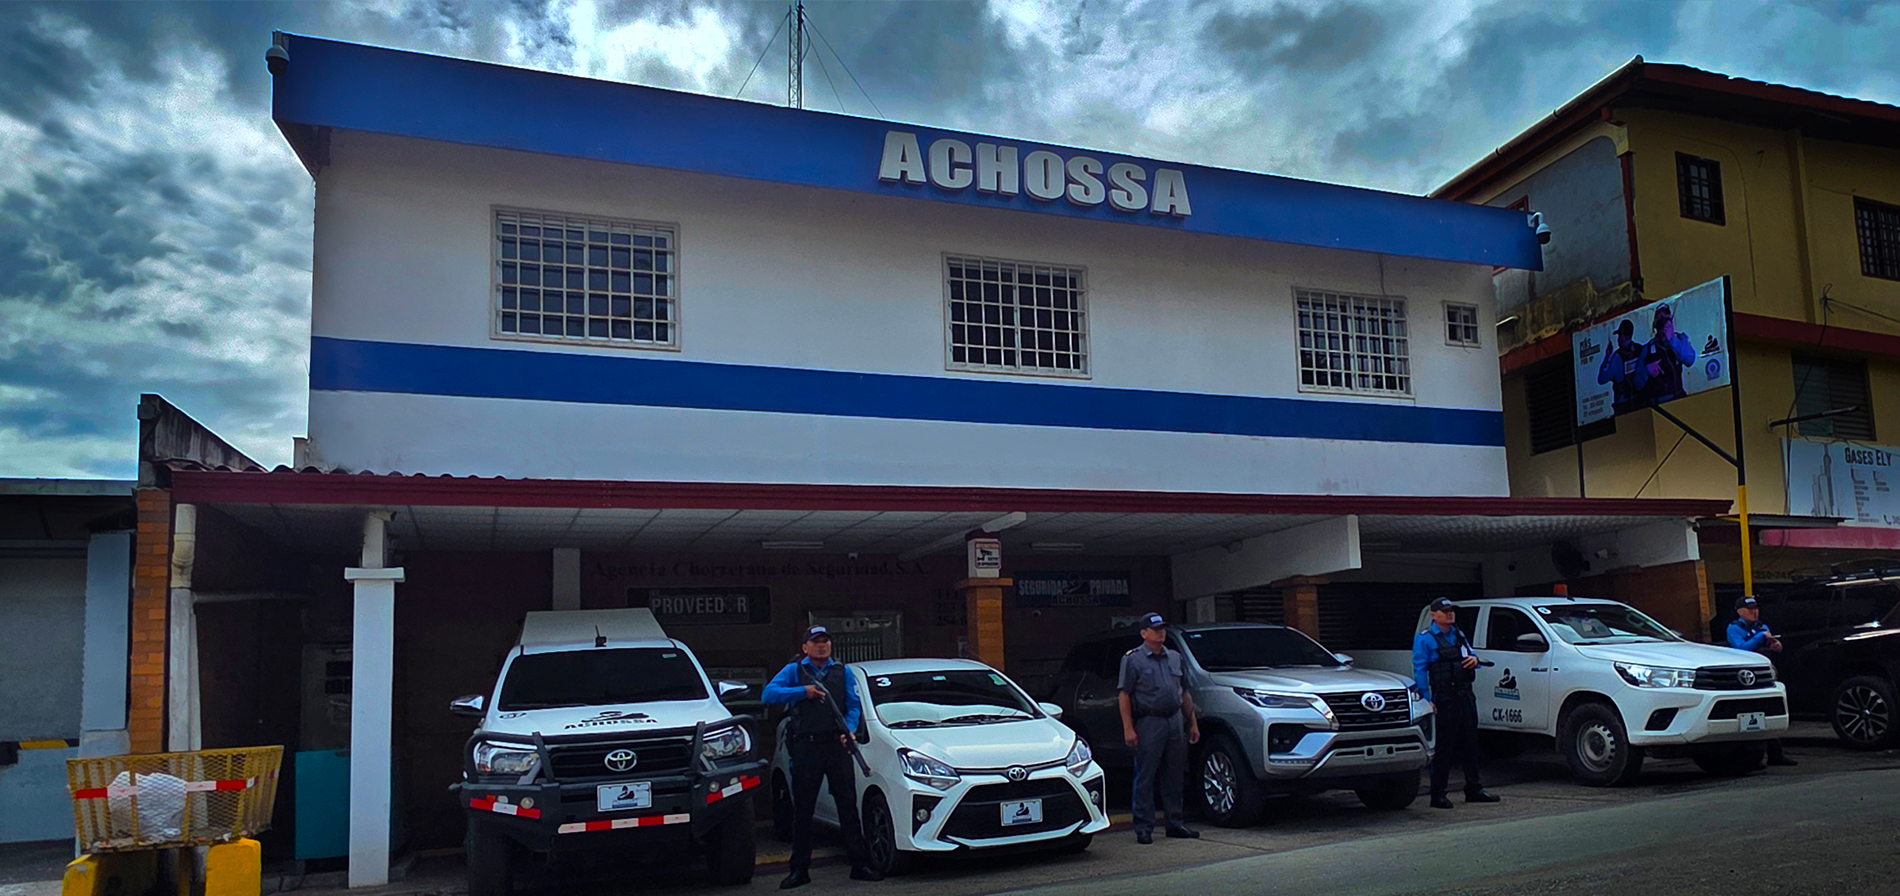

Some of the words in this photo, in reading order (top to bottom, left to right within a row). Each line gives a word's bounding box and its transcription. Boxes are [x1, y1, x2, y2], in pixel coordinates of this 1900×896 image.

[878, 130, 1192, 217] ACHOSSA
[1844, 447, 1874, 466] GASES
[1875, 450, 1892, 467] ELY
[592, 561, 666, 580] Agencia
[781, 562, 801, 576] de
[1089, 578, 1130, 596] PRIVADA
[651, 595, 748, 615] PROVEEDR
[875, 676, 893, 688] 3
[1492, 707, 1523, 724] CX-1666
